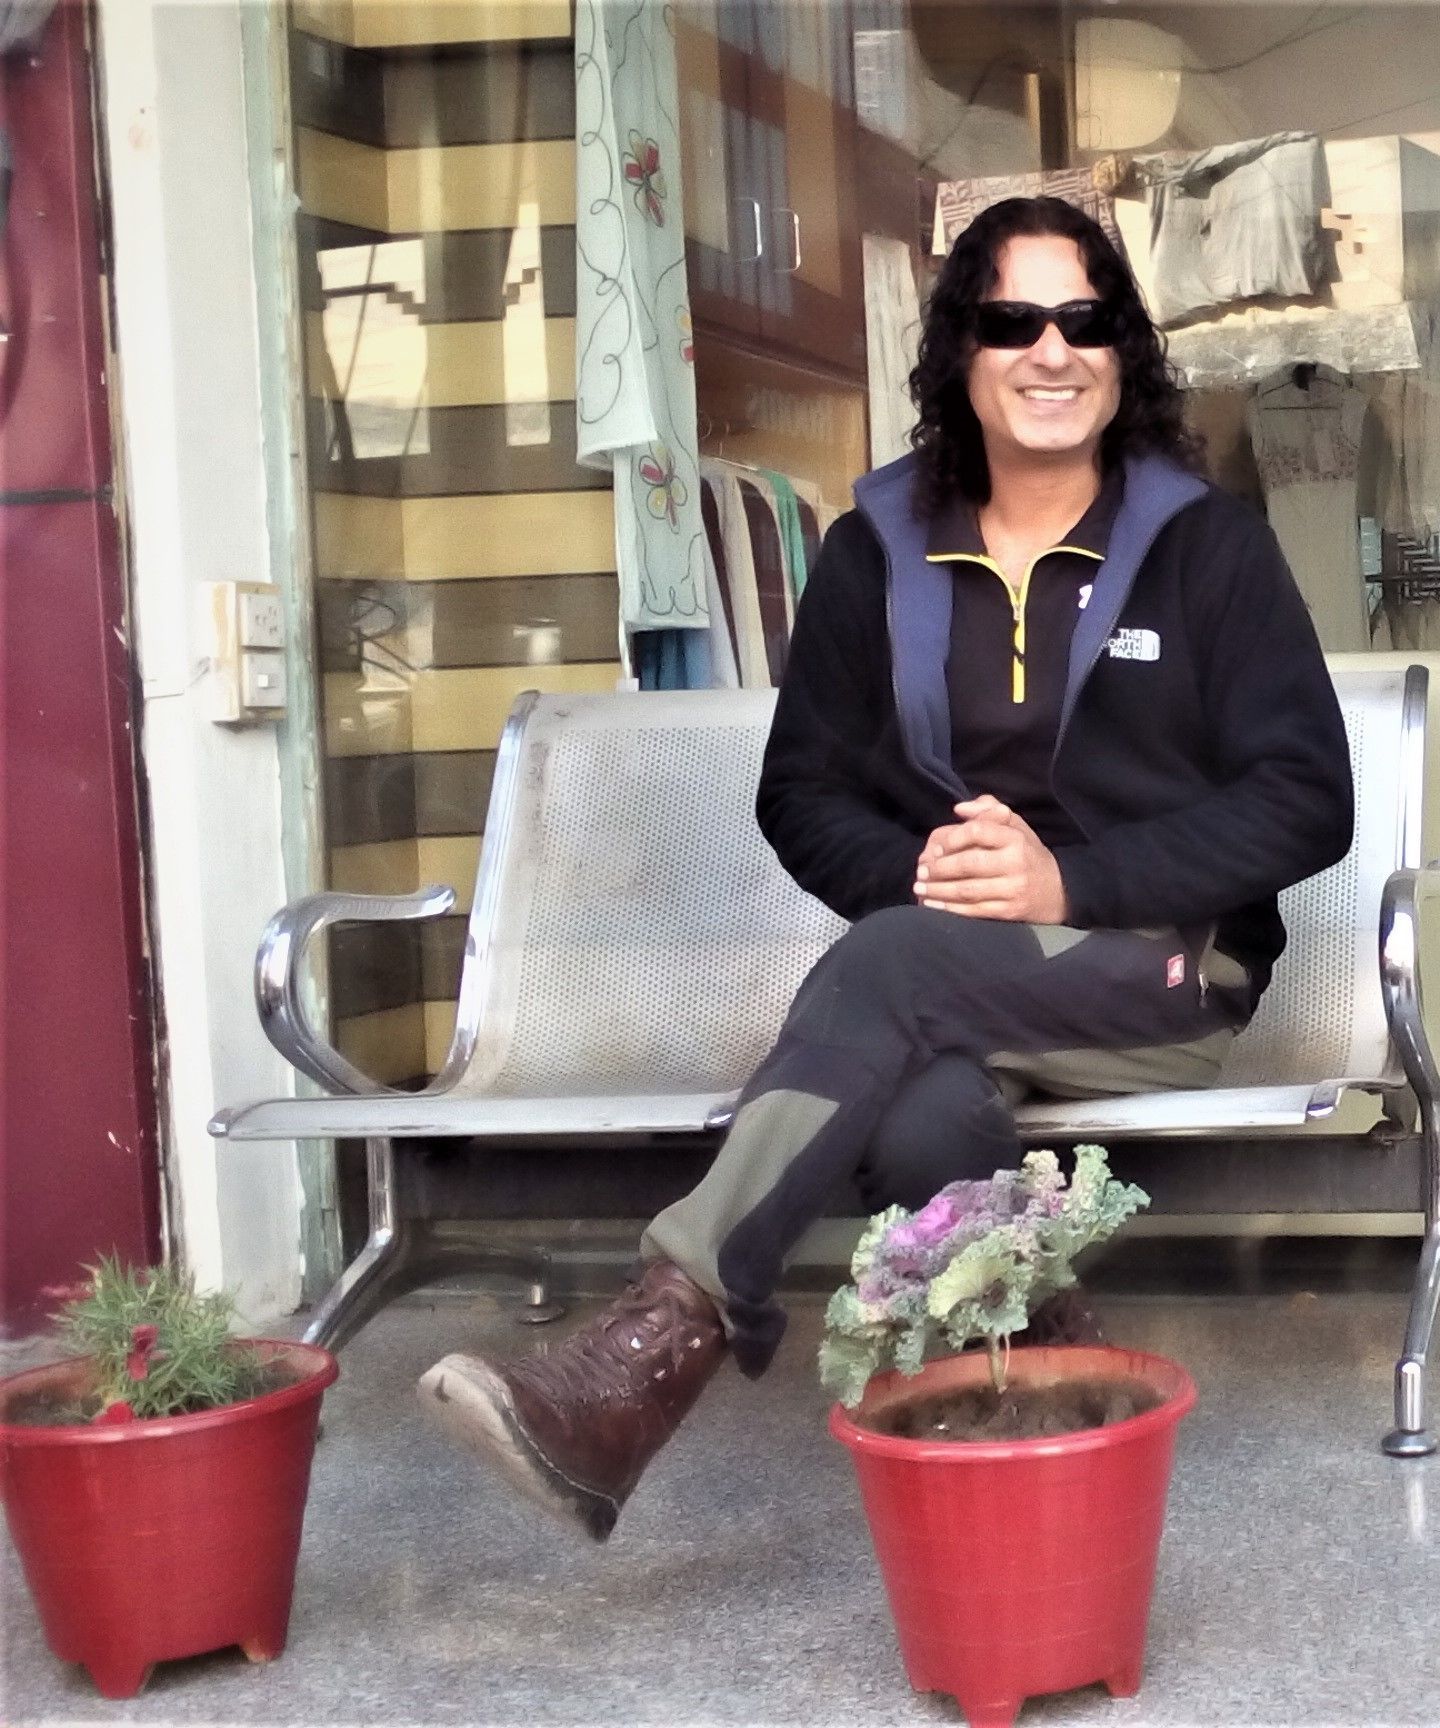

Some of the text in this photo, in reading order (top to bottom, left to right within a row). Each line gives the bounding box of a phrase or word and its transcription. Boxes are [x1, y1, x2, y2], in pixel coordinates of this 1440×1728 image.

[1118, 628, 1141, 639] THE
[1107, 638, 1142, 650] ORTH
[1109, 649, 1141, 659] FACE
